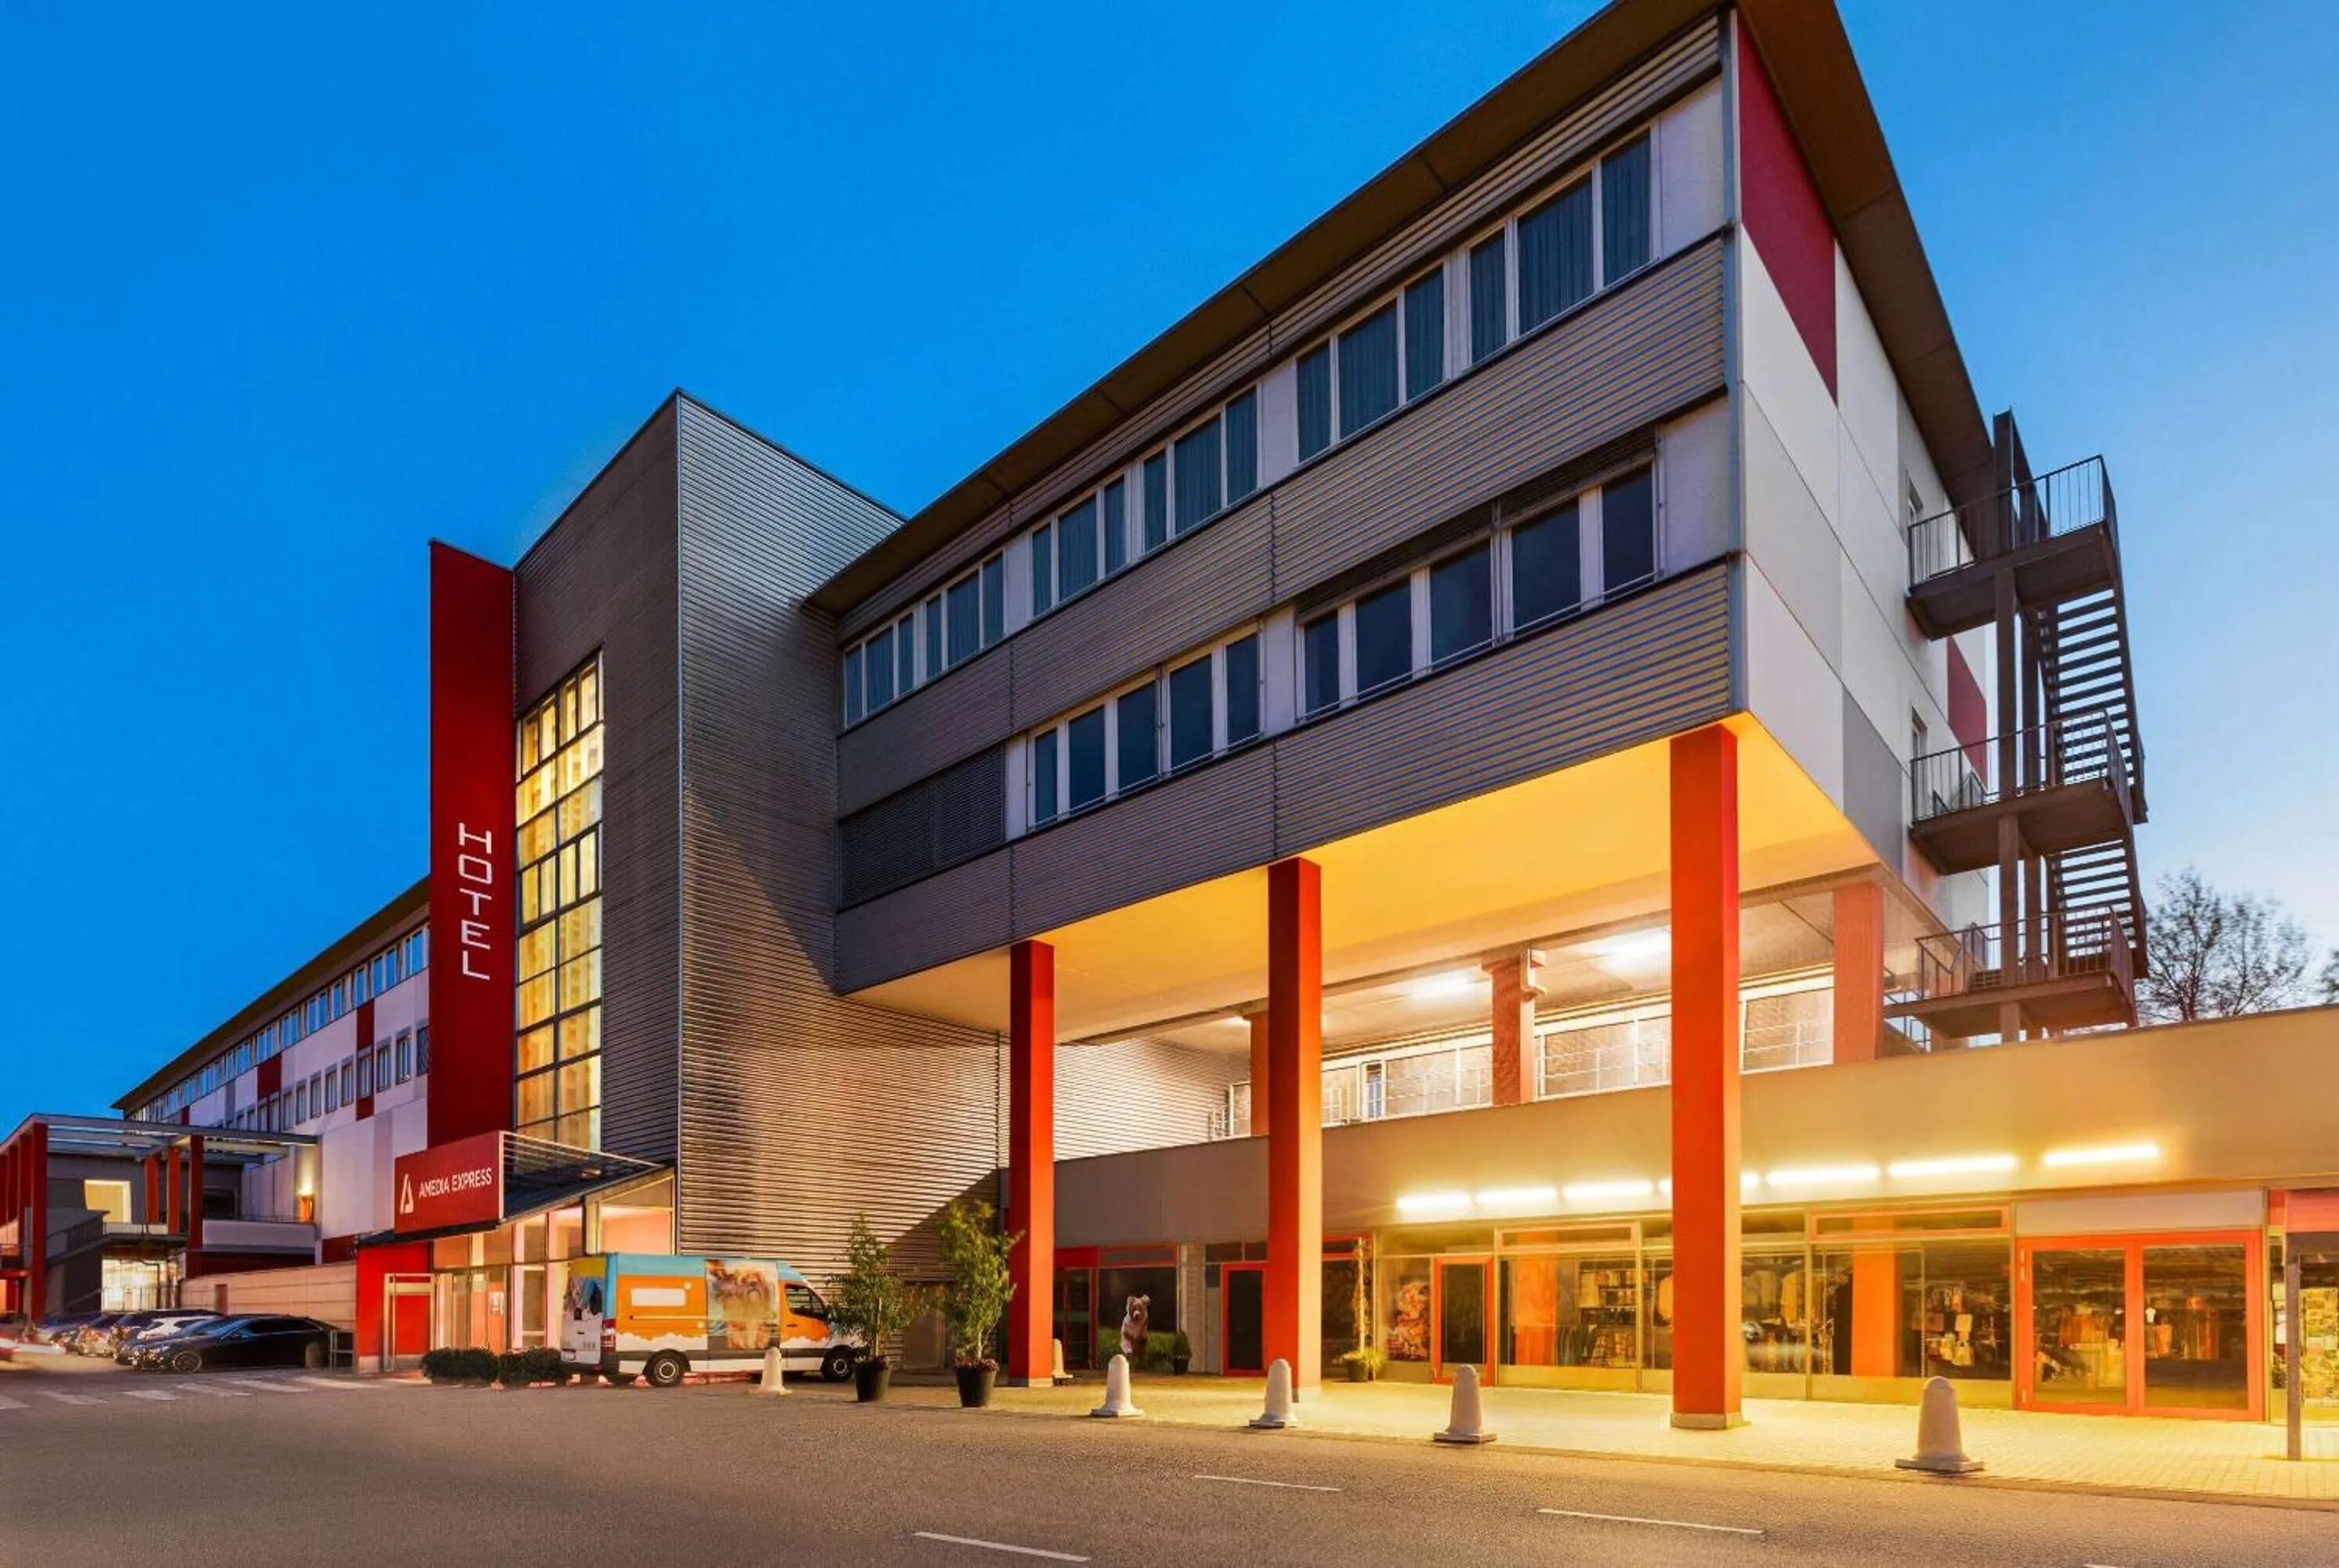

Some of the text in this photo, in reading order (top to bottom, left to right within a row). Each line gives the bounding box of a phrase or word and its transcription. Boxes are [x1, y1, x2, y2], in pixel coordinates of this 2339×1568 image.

[459, 823, 492, 980] HOTEL
[419, 1167, 492, 1198] AMEDIA EXPRESS
